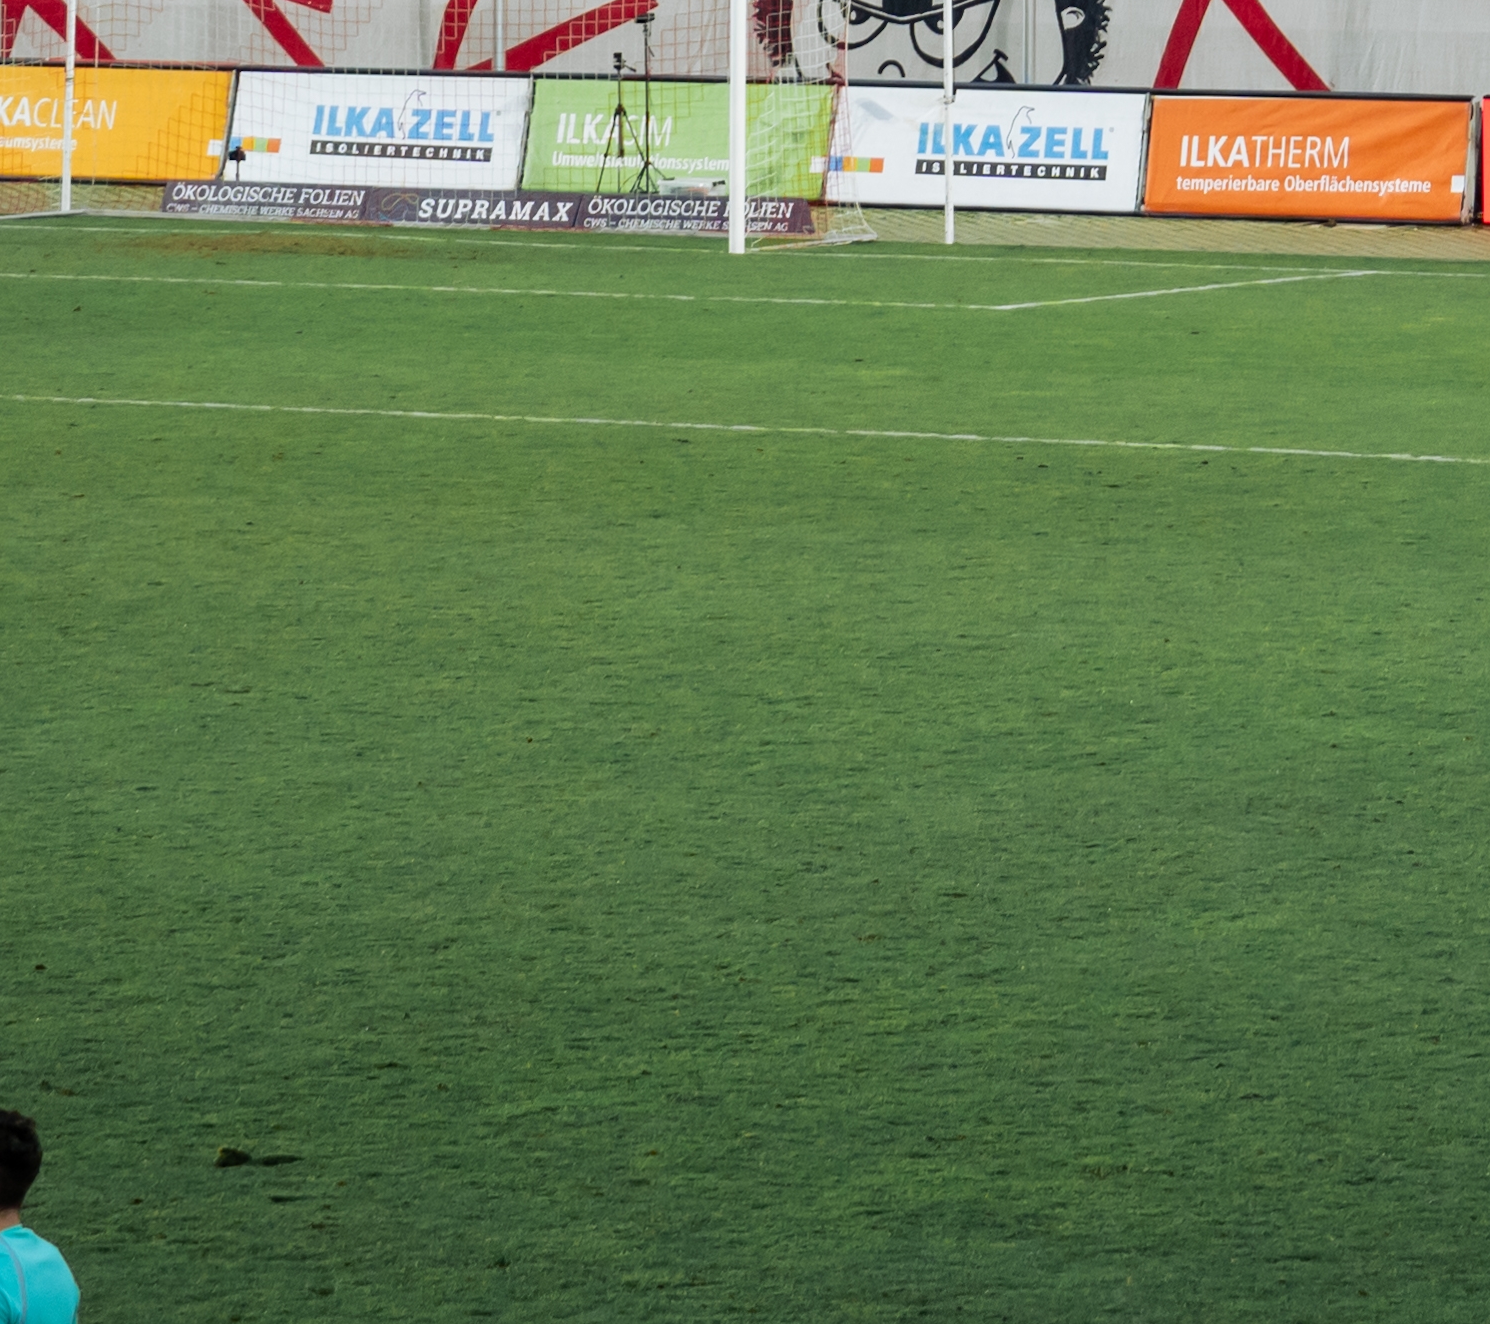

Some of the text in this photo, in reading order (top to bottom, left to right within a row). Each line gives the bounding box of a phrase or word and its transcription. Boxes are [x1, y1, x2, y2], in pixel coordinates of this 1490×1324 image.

[313, 104, 494, 142] ILKA ZELL
[315, 141, 490, 162] ISOLIERTECHNIK
[918, 121, 1110, 161] ILKA ZELL
[1180, 134, 1349, 170] ILKATHERM
[922, 161, 1100, 180] ISLIERTECHNIK
[172, 181, 365, 206] ÖKOLOGISCHE FOLIEN
[1176, 174, 1431, 196] temperierbare Oberflächensysteme
[167, 202, 359, 219] CWS CHEMISCHE WERKE SACHSEN AG
[419, 198, 574, 223] SUPRAMAX
[588, 195, 719, 217] ÖKOLOGISCHE
[584, 218, 788, 232] CWS CHEMISCHE WERKE SSEN AG
